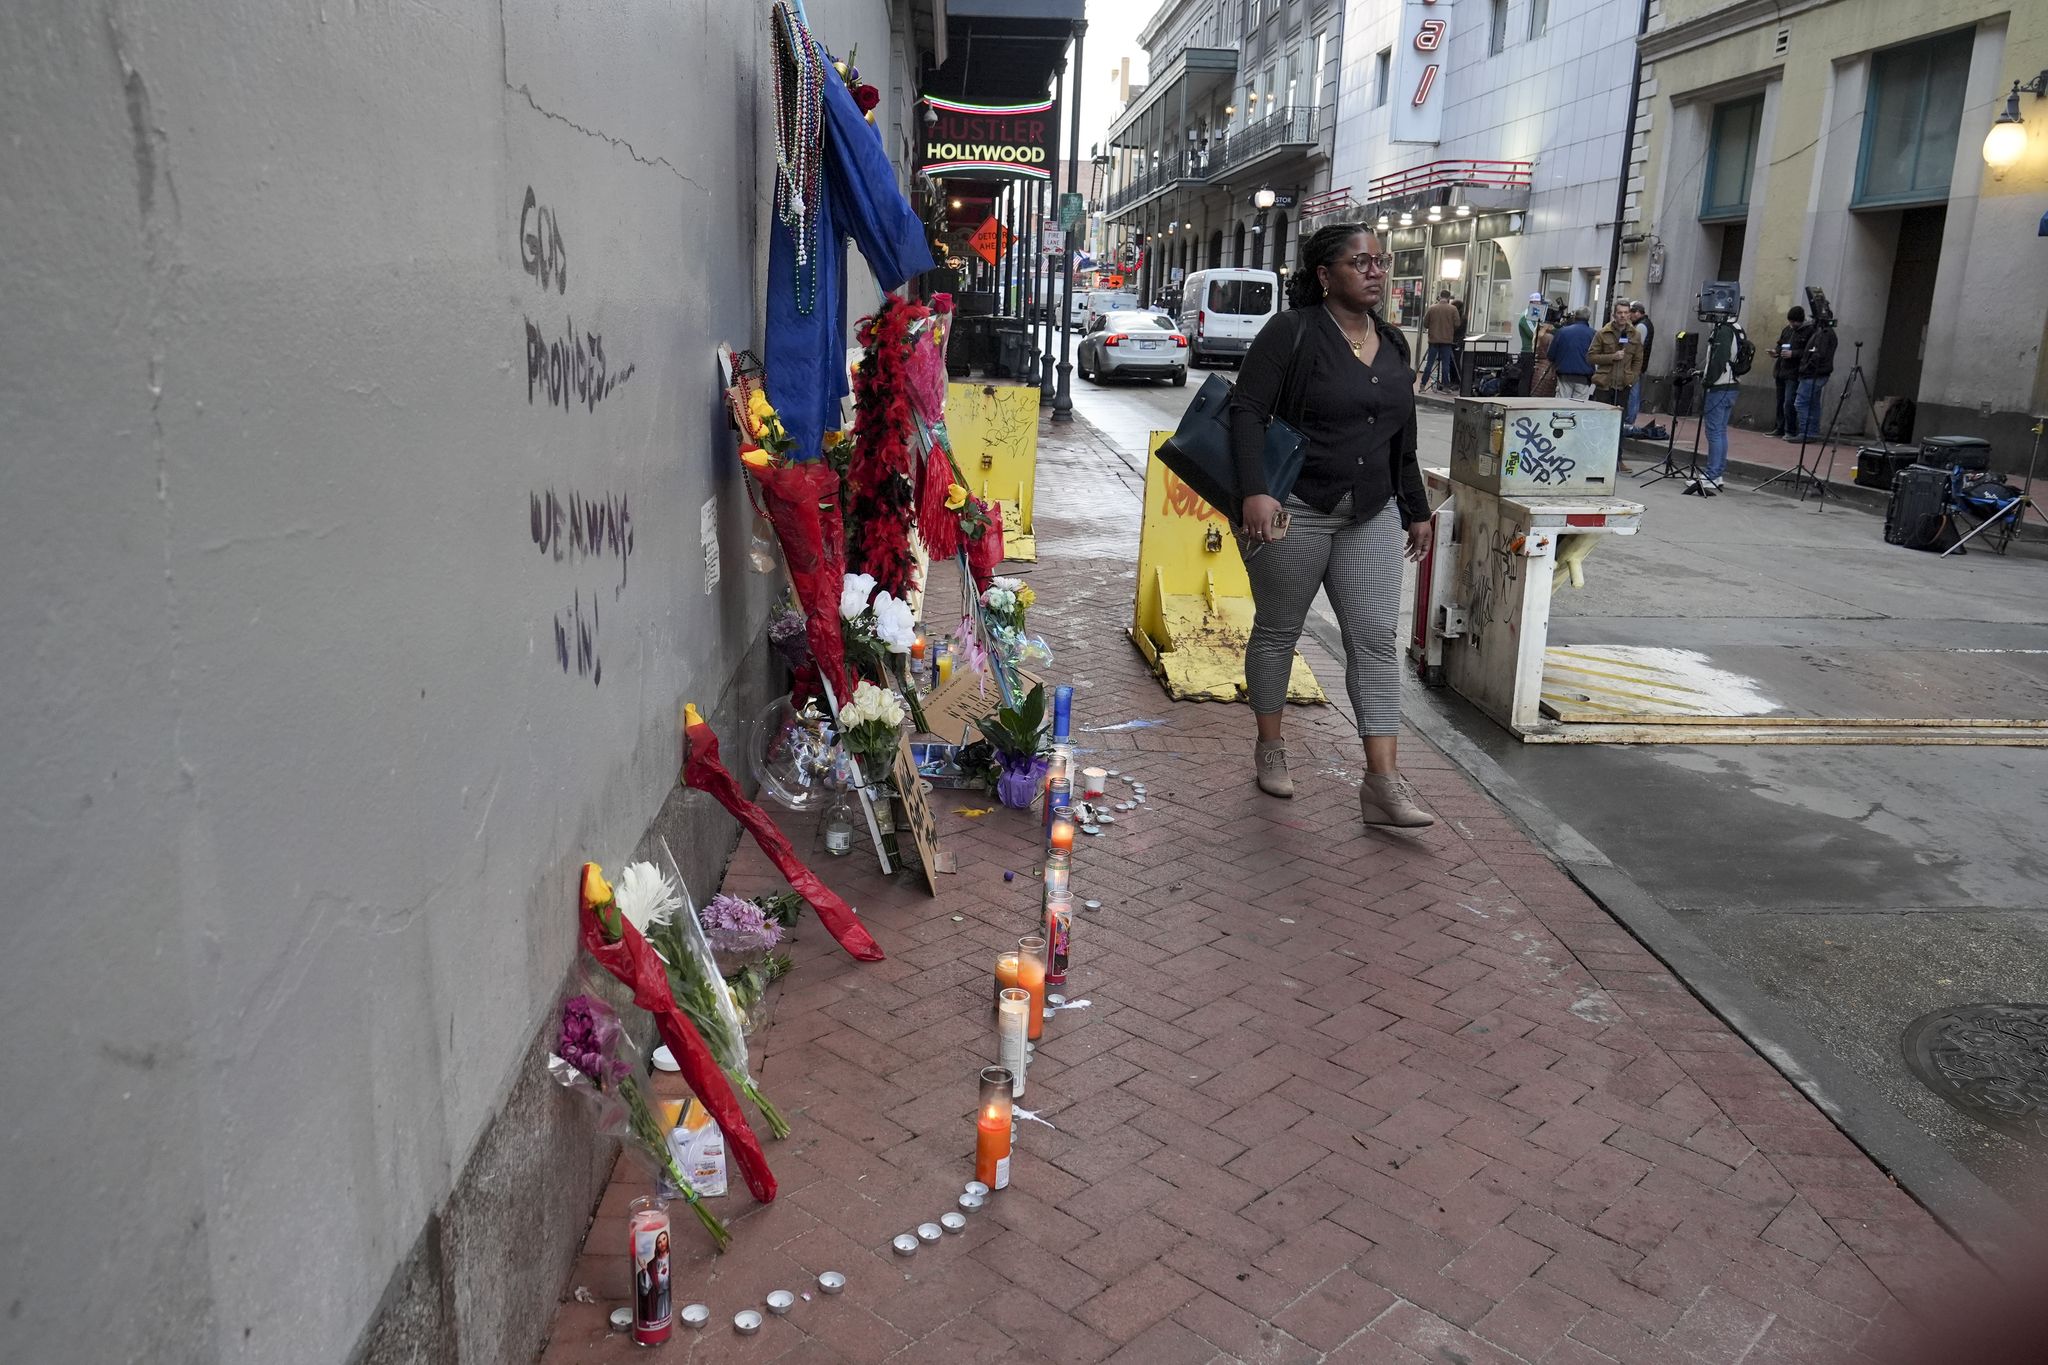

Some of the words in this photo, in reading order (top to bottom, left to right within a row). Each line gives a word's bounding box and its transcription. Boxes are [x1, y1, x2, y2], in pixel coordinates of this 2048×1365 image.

[1411, 0, 1447, 106] al
[927, 117, 1046, 143] HUSTLER
[927, 143, 1045, 162] HOLLYWOOD
[520, 185, 567, 295] GOD
[978, 232, 1008, 240] DETOR
[980, 242, 1007, 250] AHED
